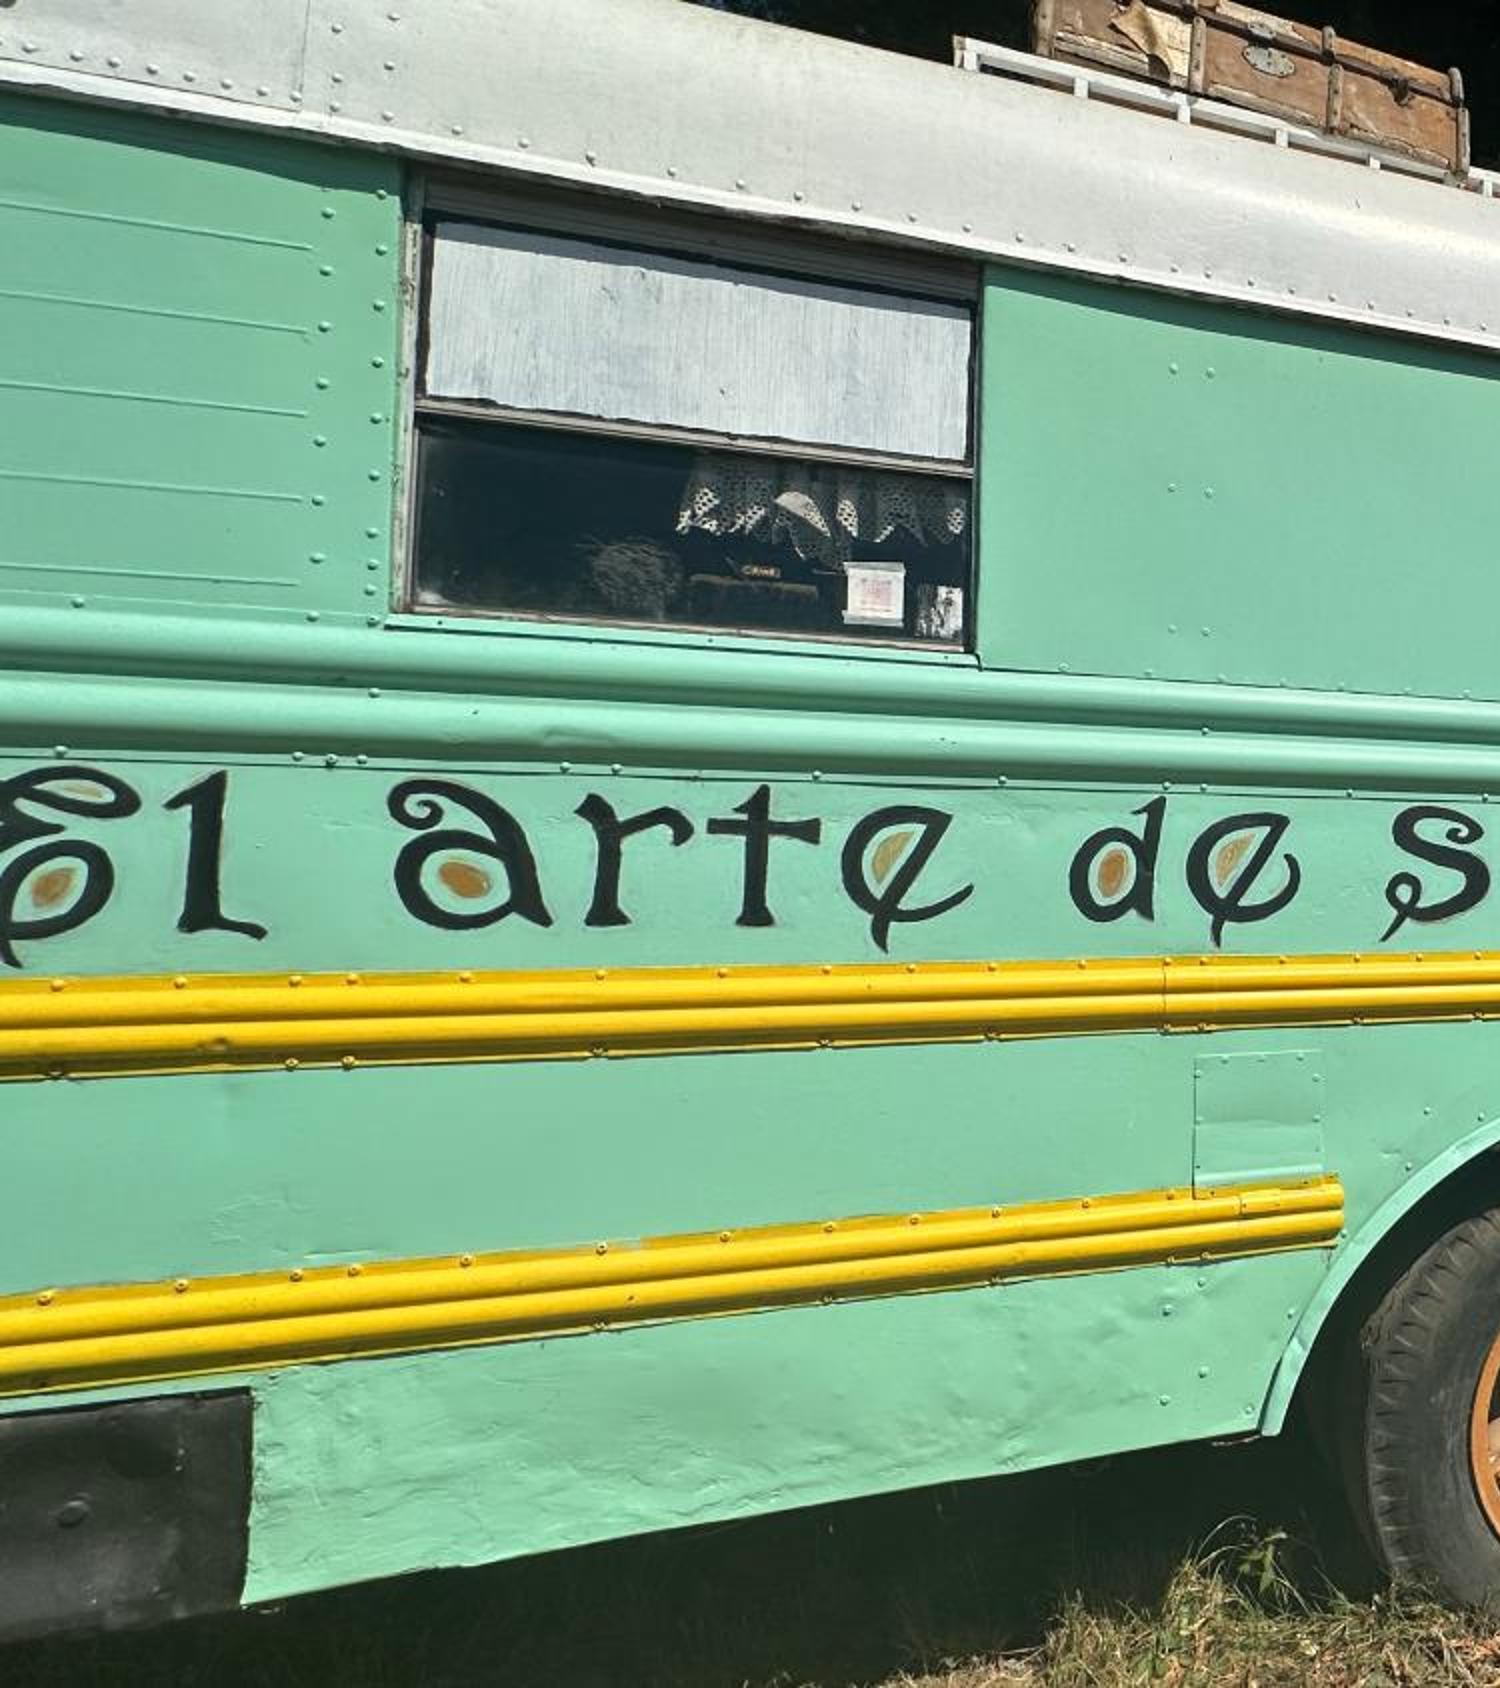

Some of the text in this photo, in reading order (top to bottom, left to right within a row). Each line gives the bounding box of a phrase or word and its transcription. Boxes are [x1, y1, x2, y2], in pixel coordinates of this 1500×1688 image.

[0, 765, 268, 968] El
[386, 778, 974, 953] arte
[1069, 796, 1300, 948] de
